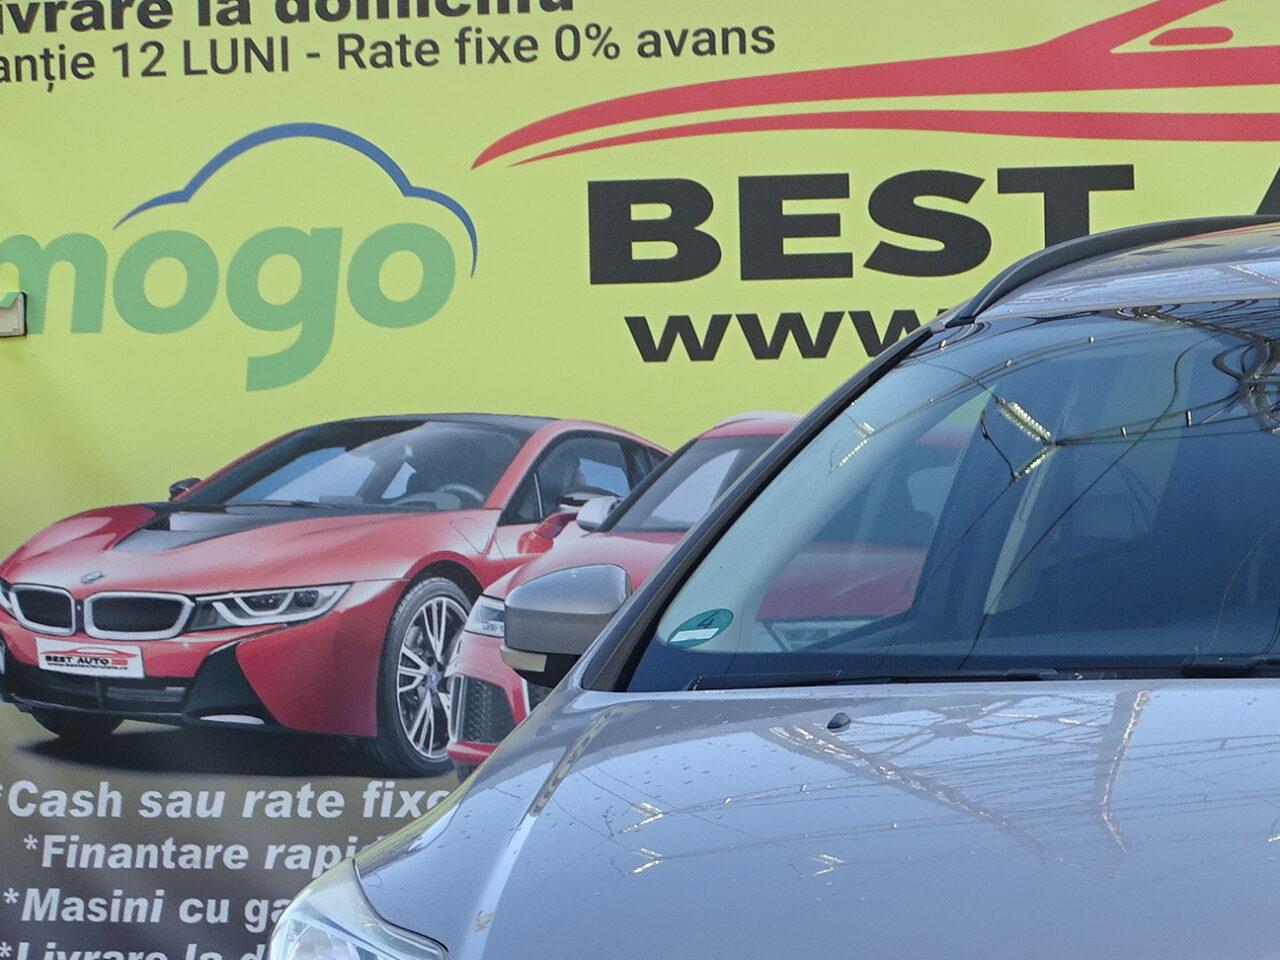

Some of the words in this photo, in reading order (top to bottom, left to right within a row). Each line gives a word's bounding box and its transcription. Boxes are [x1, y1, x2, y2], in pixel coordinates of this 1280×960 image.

[0, 0, 173, 34] vrare
[112, 40, 167, 77] 12
[183, 35, 289, 76] LUNI
[337, 32, 440, 70] Rate
[455, 26, 539, 65] fixe
[555, 22, 620, 62] 0%
[637, 25, 776, 59] avans
[587, 163, 1135, 285] BEST
[0, 222, 456, 392] mogo
[0, 779, 123, 818] Cash
[138, 788, 224, 818] sau
[242, 781, 345, 818] rate
[179, 899, 229, 923] cu
